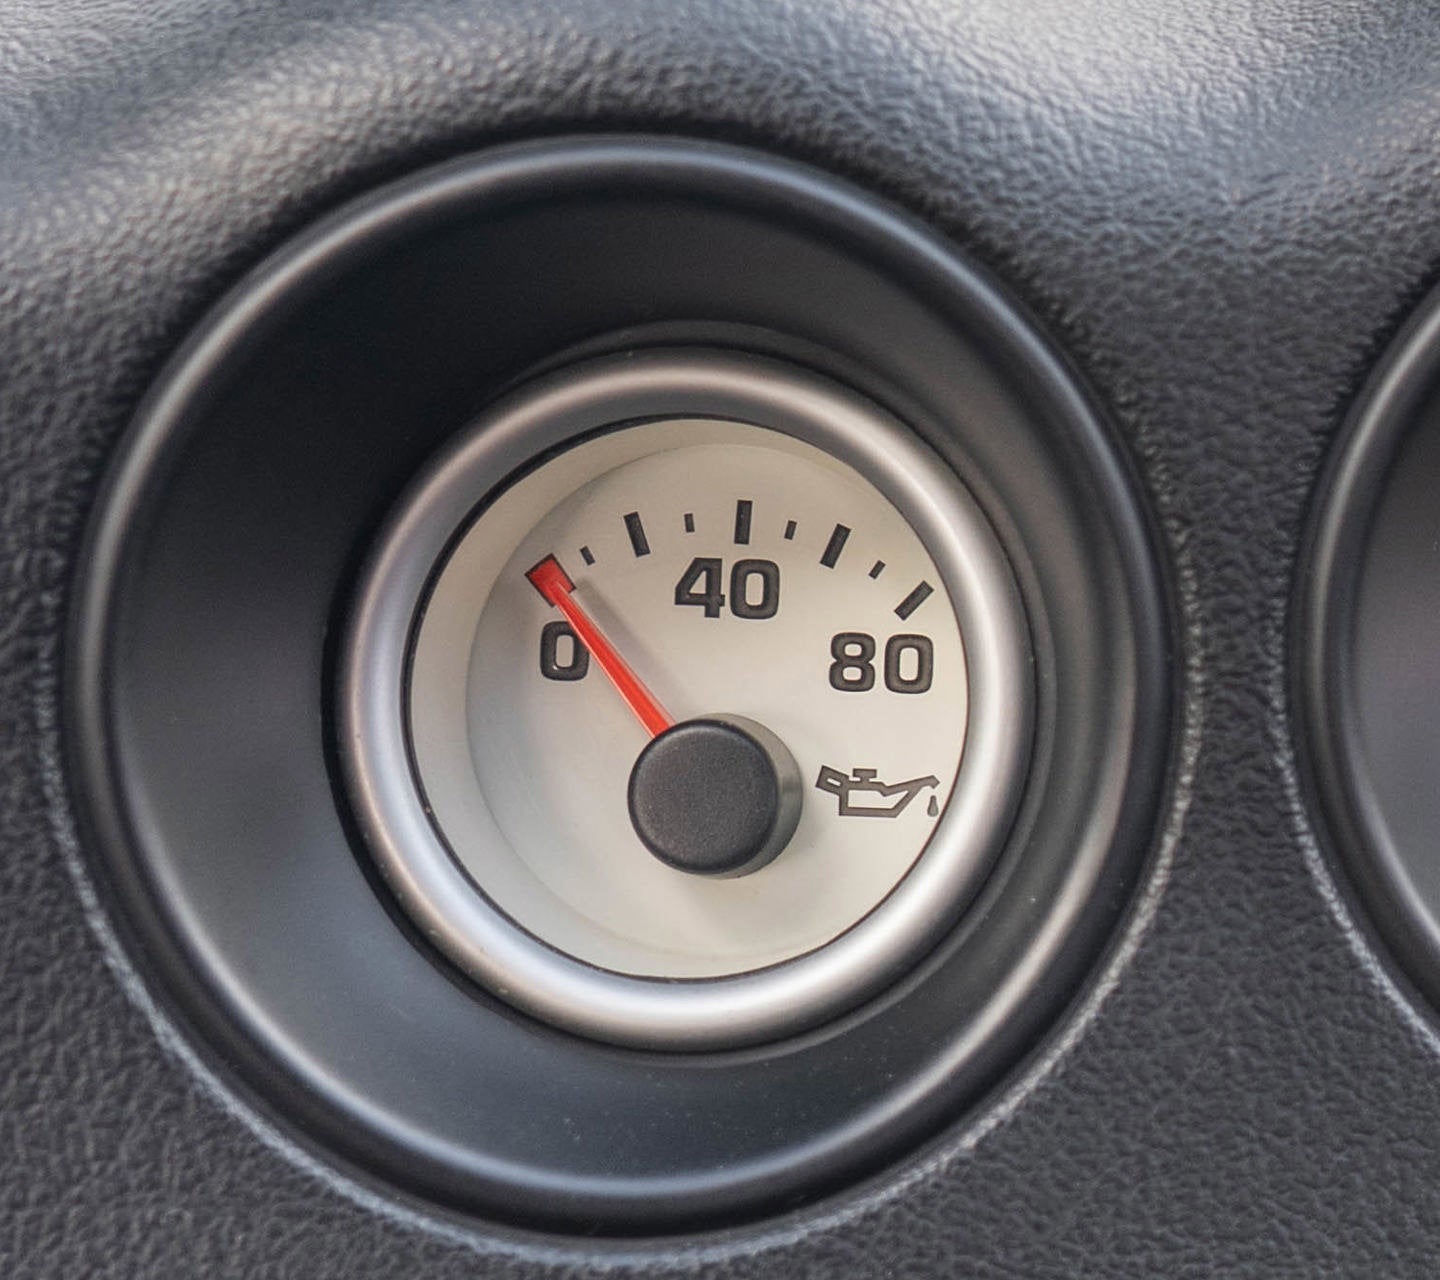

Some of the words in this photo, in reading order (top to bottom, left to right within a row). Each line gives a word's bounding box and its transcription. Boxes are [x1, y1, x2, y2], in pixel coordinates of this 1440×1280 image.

[673, 557, 781, 620] 40
[539, 621, 590, 682] 0
[828, 632, 935, 695] 80
